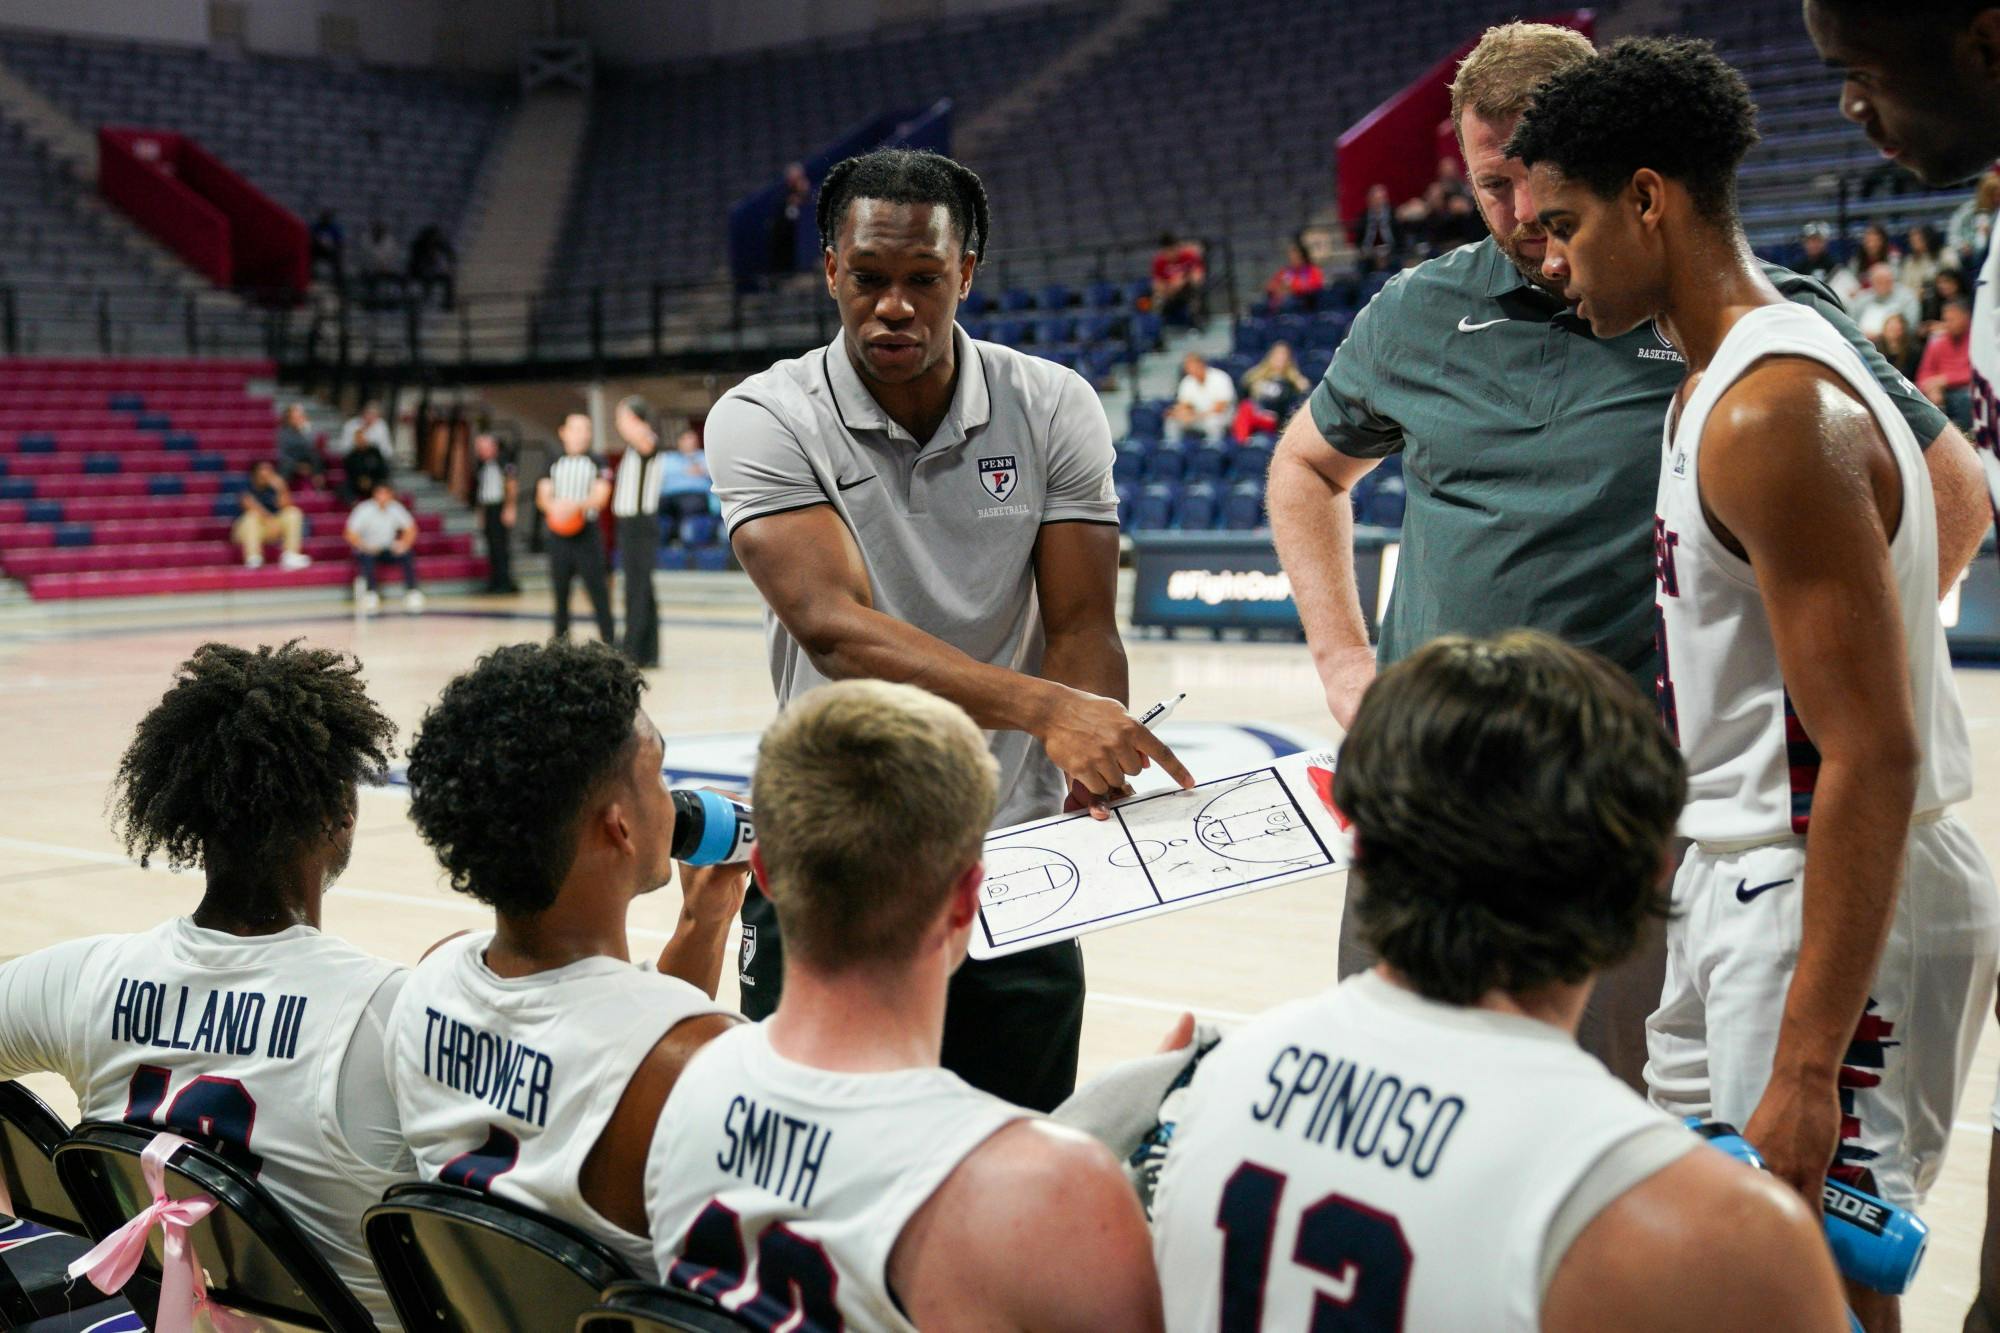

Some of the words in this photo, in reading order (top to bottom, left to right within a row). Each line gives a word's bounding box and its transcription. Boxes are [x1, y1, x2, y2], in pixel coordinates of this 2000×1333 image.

[980, 458, 1014, 470] PENN
[991, 470, 1010, 494] P
[978, 504, 1030, 518] BASKETBALL
[111, 977, 266, 1056] HOLLAND
[266, 994, 308, 1060] III
[423, 1006, 554, 1128] THROWER
[717, 1095, 832, 1209] SMITH
[1251, 1045, 1466, 1180] SPINOSO
